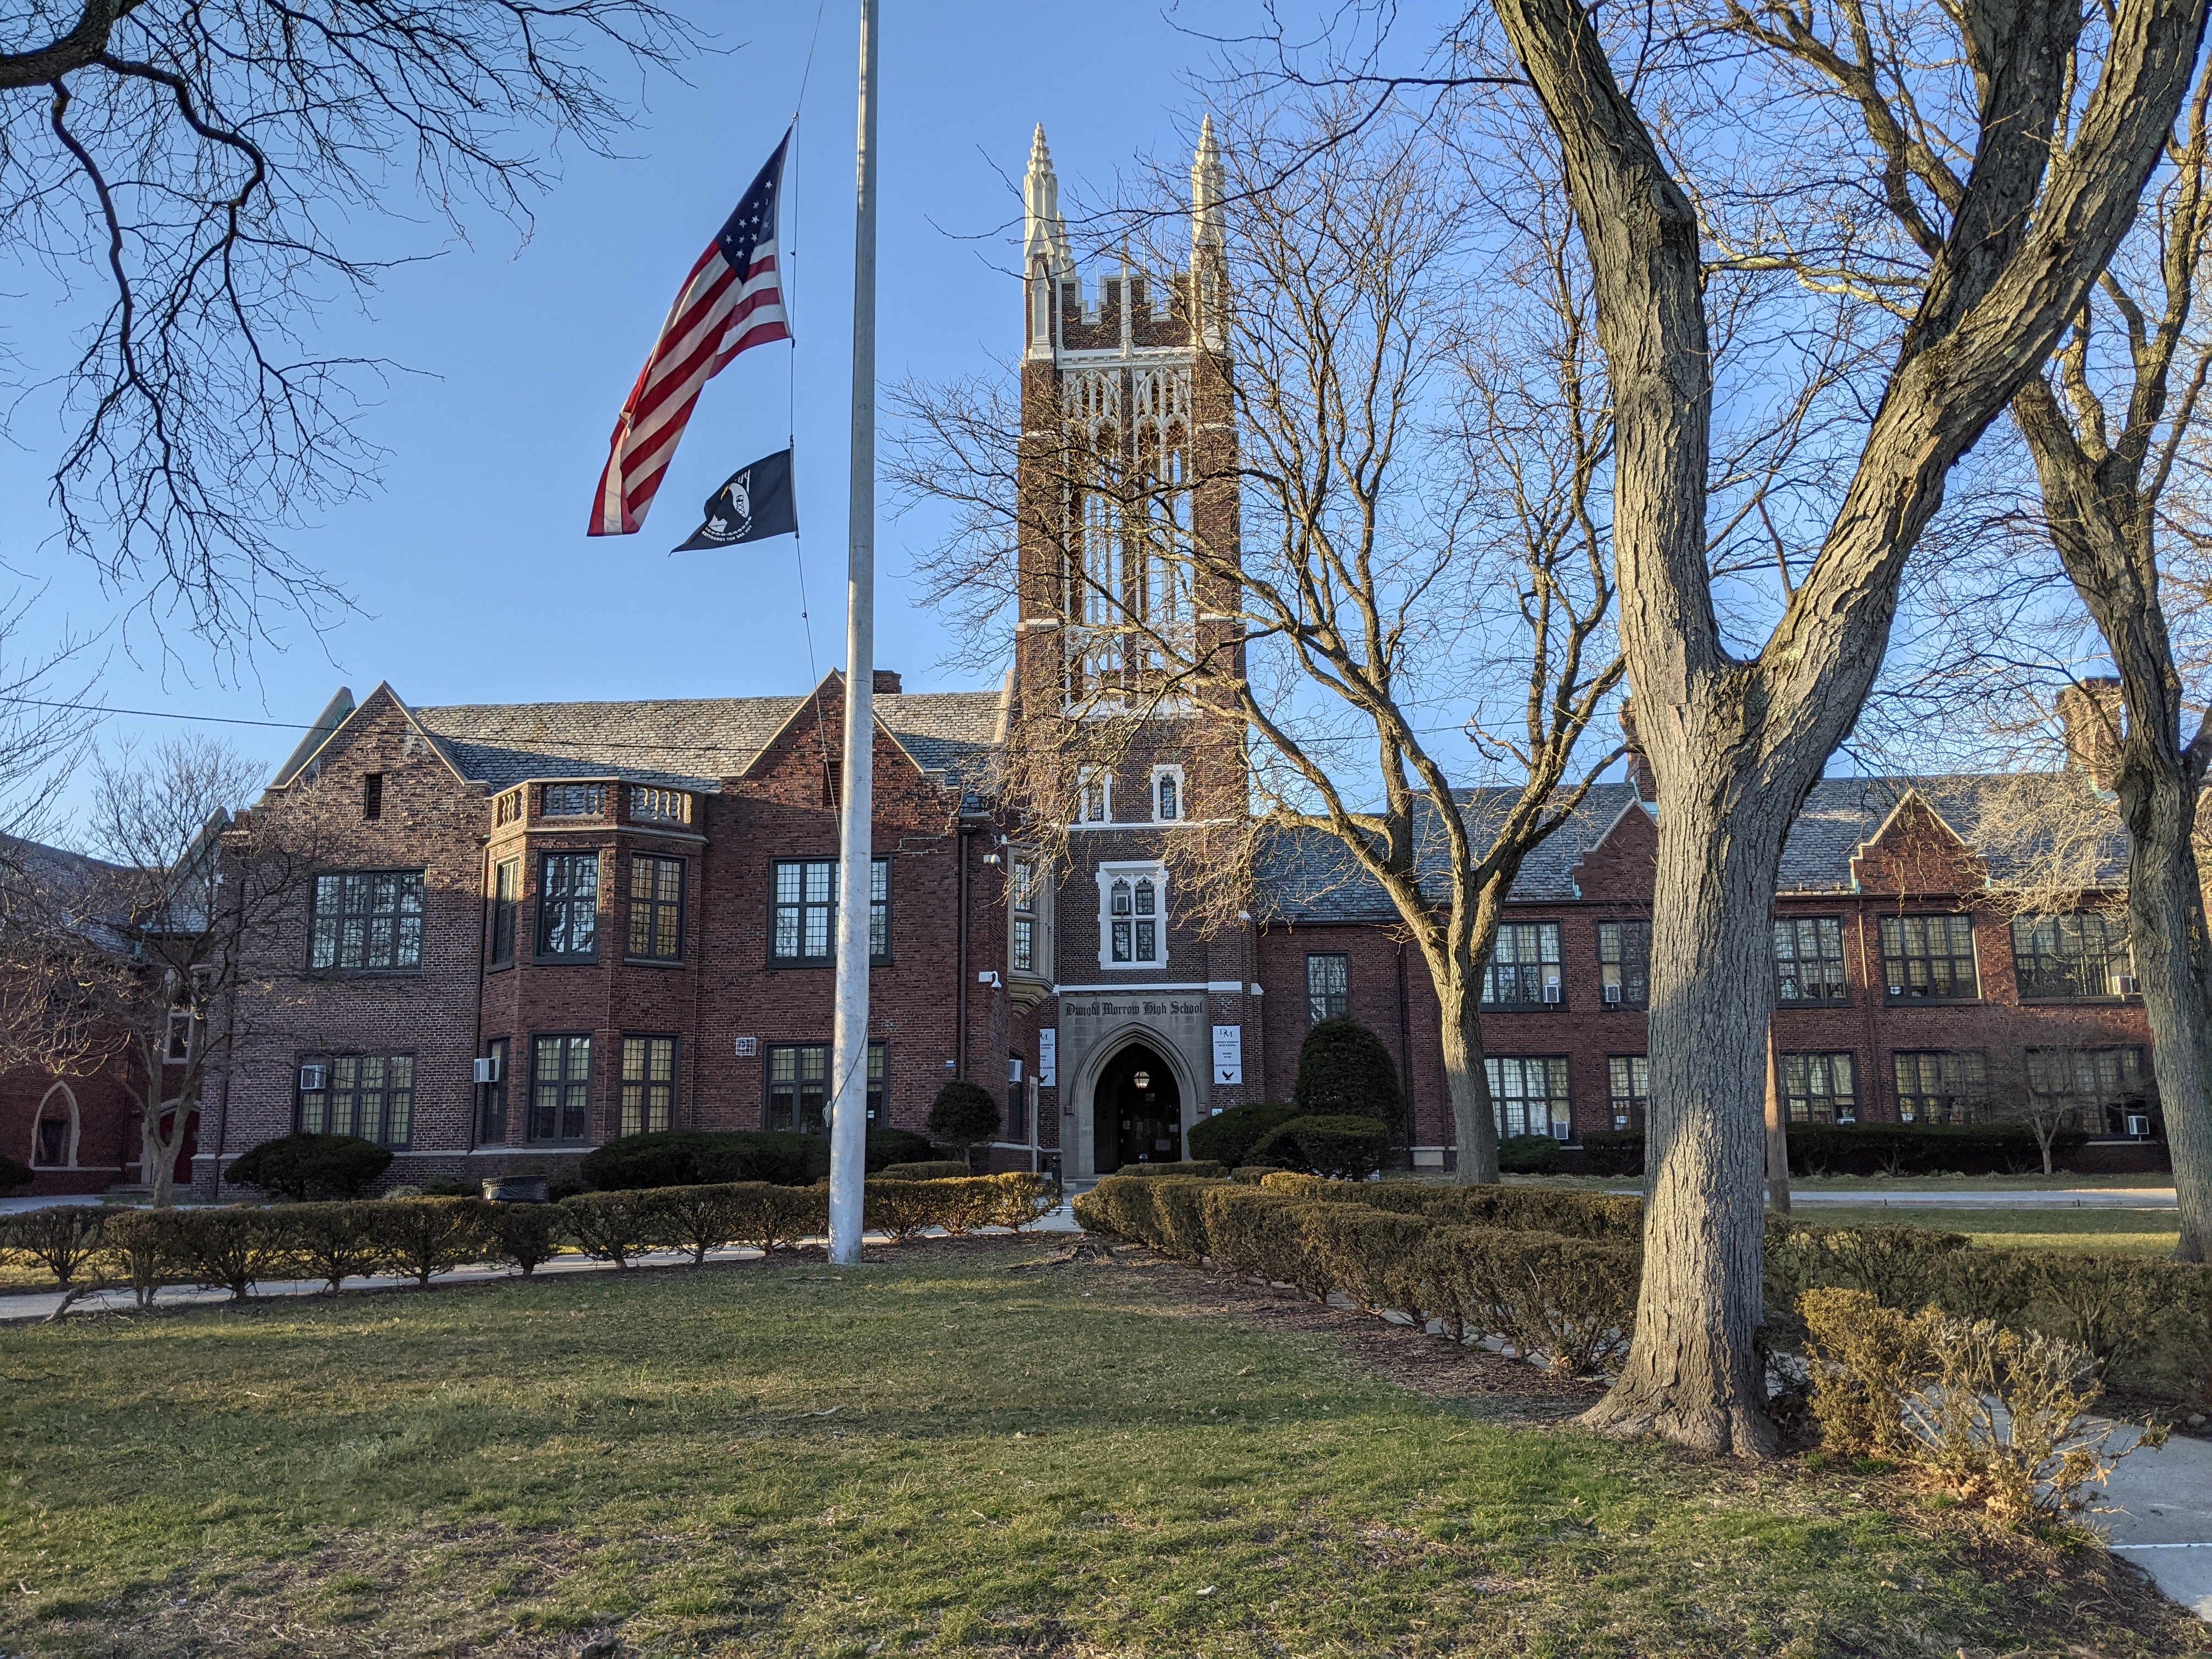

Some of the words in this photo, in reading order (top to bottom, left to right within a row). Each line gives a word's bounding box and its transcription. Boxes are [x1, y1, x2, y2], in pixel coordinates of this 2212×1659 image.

[1066, 1002, 1100, 1017] Dwight
[1101, 1002, 1139, 1015] Morrow
[1143, 1001, 1167, 1015] High
[1171, 1001, 1203, 1014] School
[1220, 1029, 1233, 1037] DM
